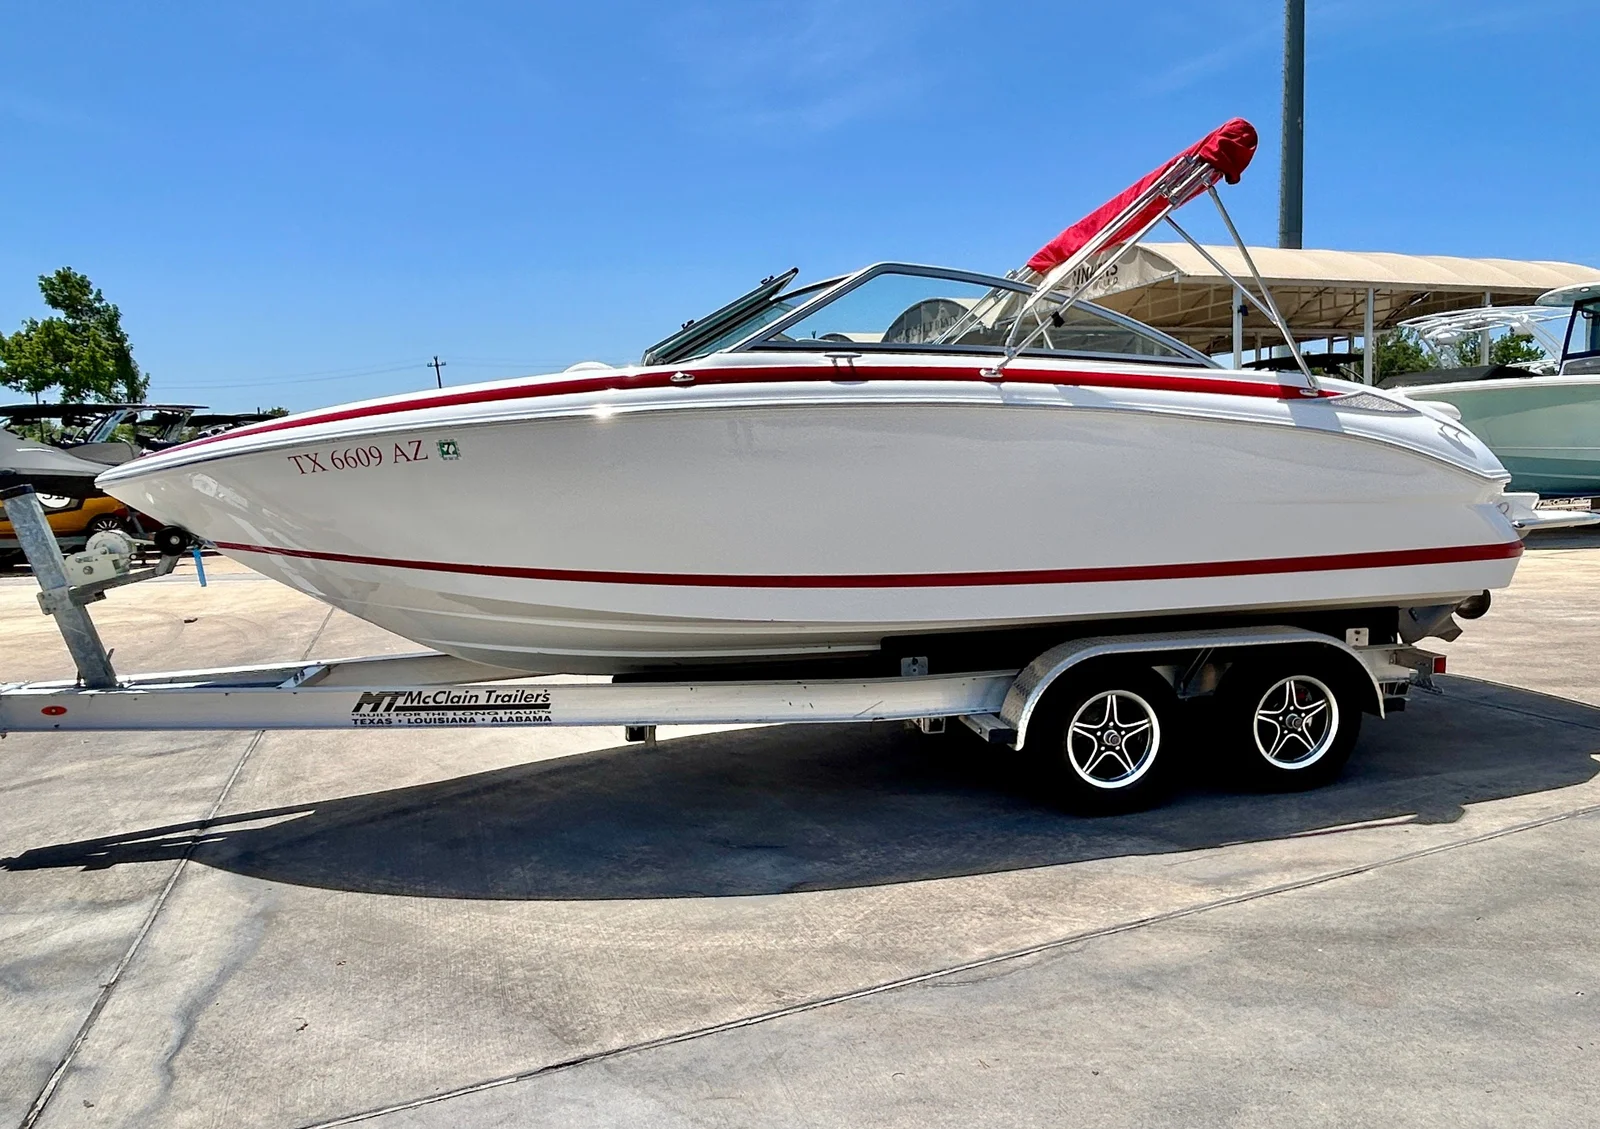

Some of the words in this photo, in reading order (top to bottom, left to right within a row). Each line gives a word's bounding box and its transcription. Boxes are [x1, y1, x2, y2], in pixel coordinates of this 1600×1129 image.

[287, 453, 329, 475] TX
[330, 445, 383, 470] 6609
[393, 439, 429, 464] AZ
[403, 690, 479, 705] McClain
[407, 716, 476, 724] LOUISIANA
[491, 715, 552, 723] ALABAMA
